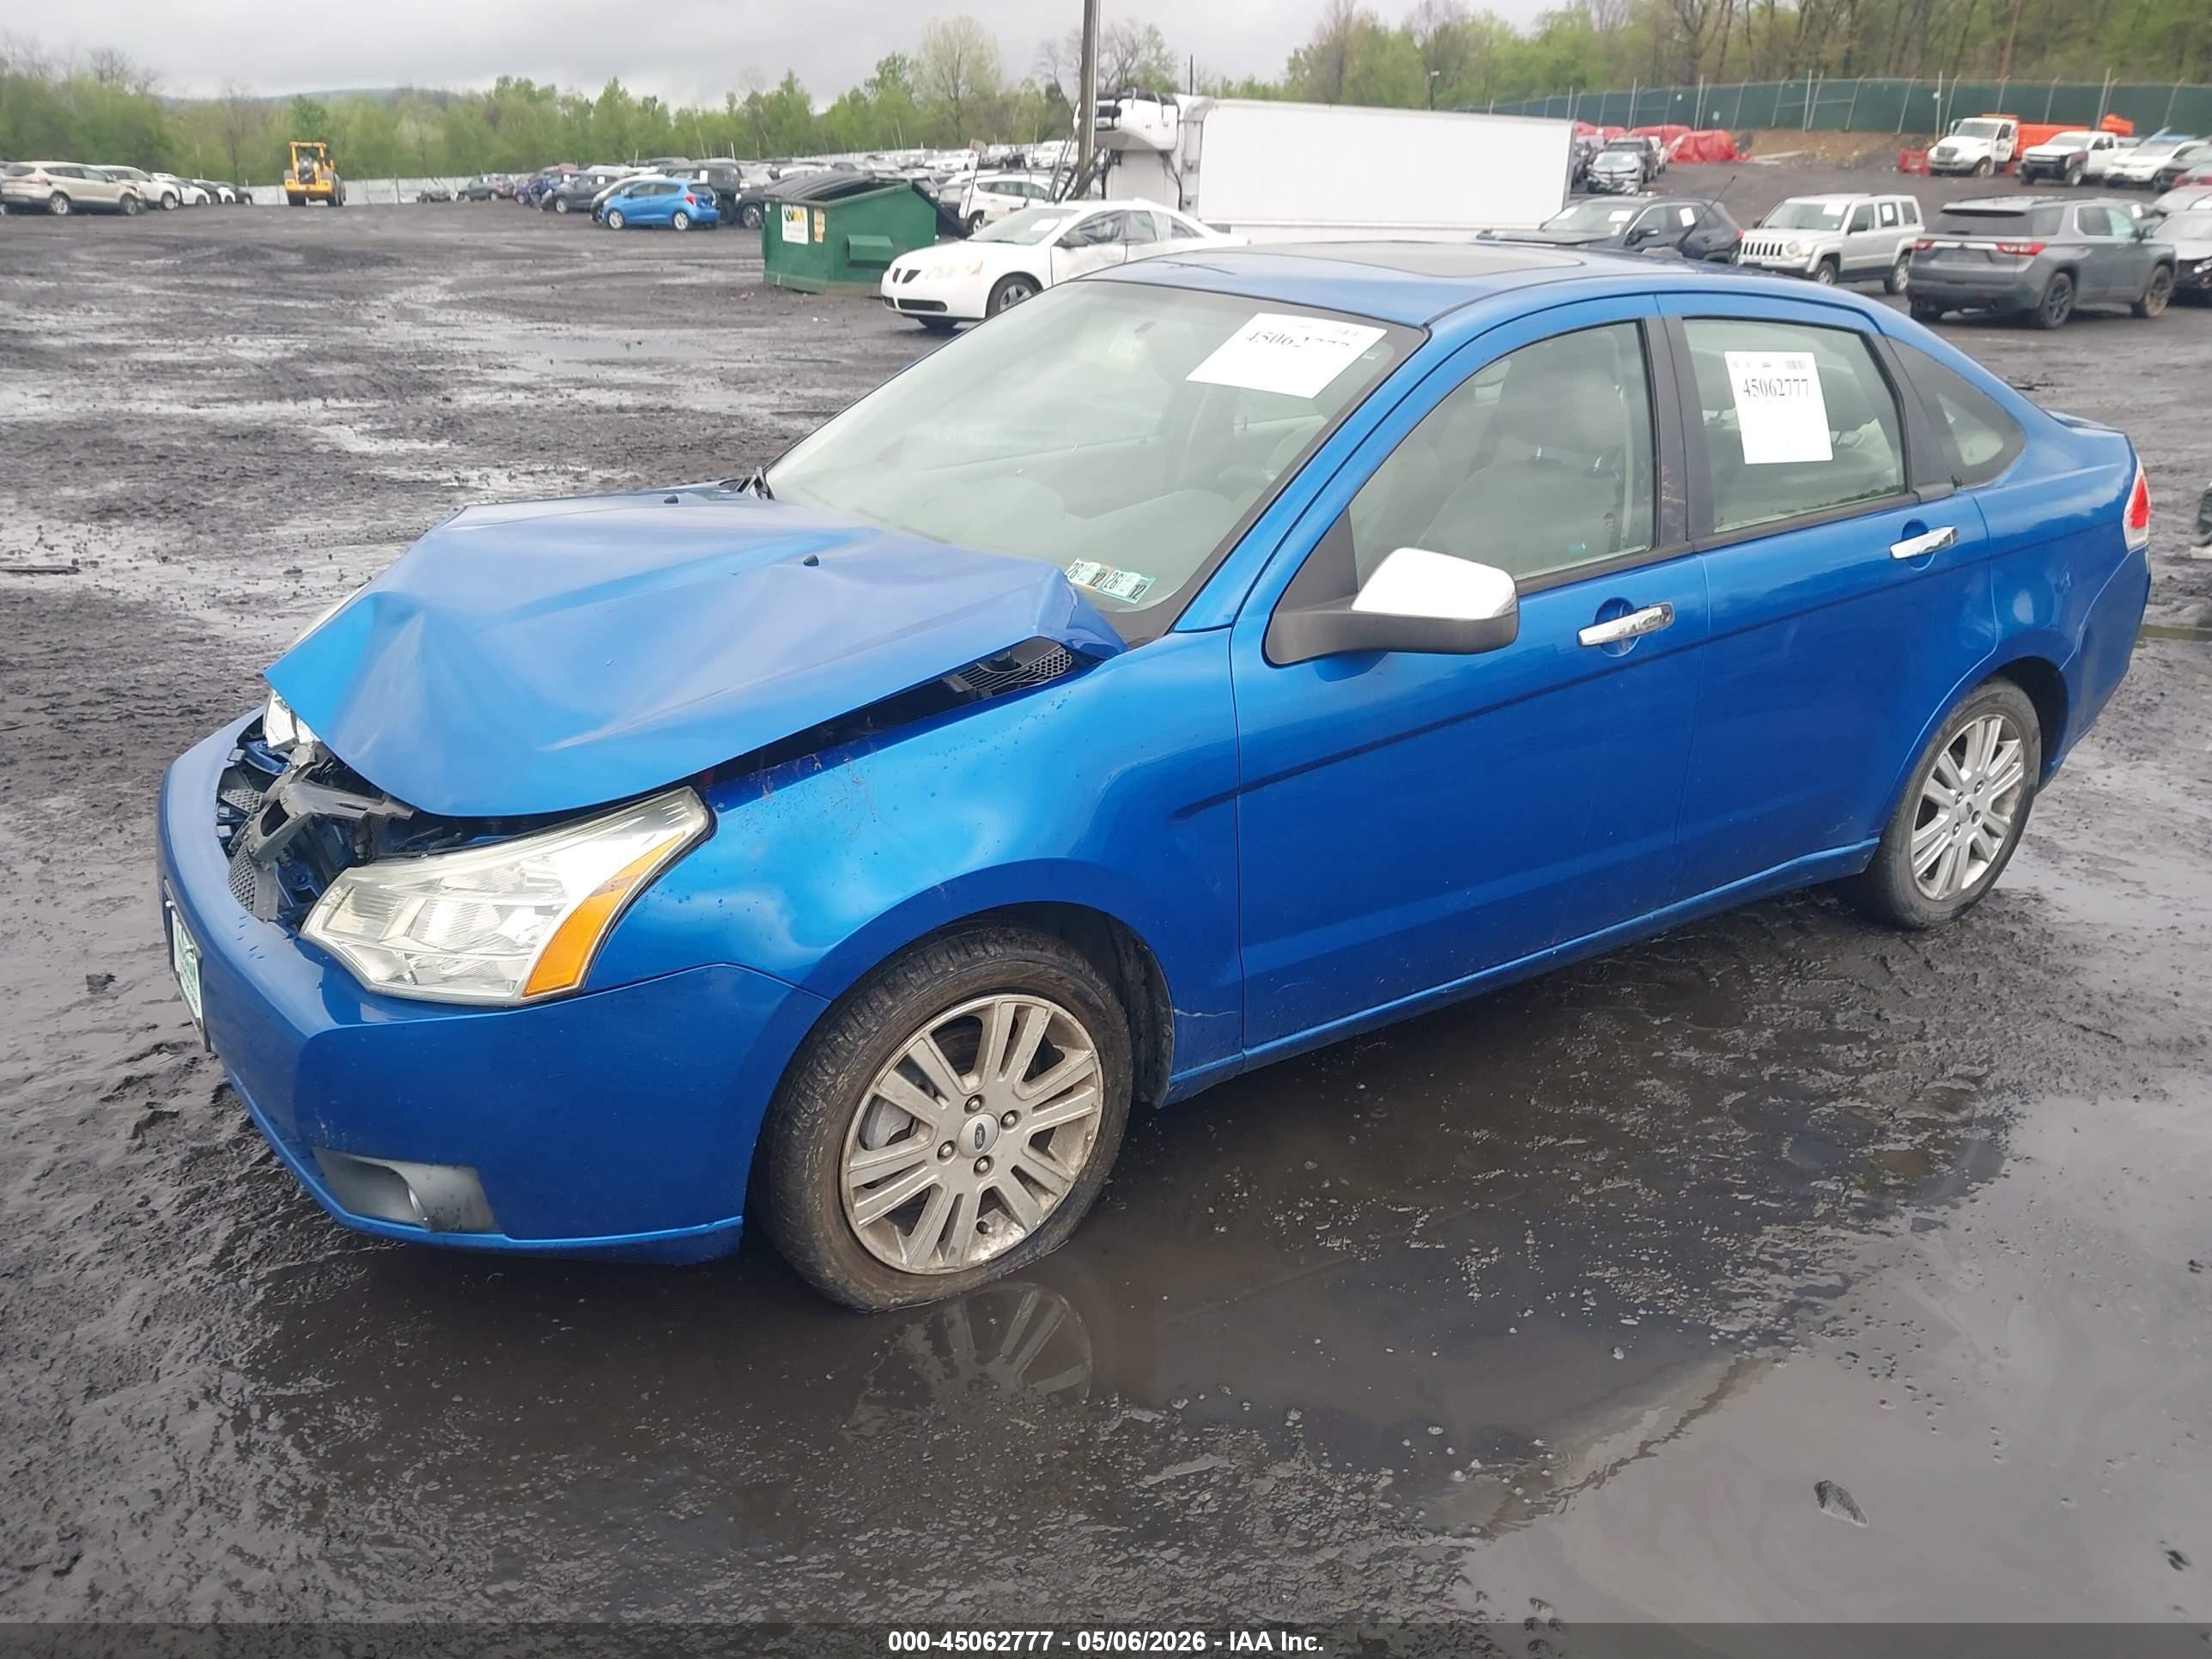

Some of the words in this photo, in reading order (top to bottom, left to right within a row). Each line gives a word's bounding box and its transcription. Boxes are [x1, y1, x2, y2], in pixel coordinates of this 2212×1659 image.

[1743, 378, 1808, 398] 45062777
[1087, 571, 1107, 587] 12
[1103, 572, 1124, 590] 26
[1128, 583, 1147, 600] 12
